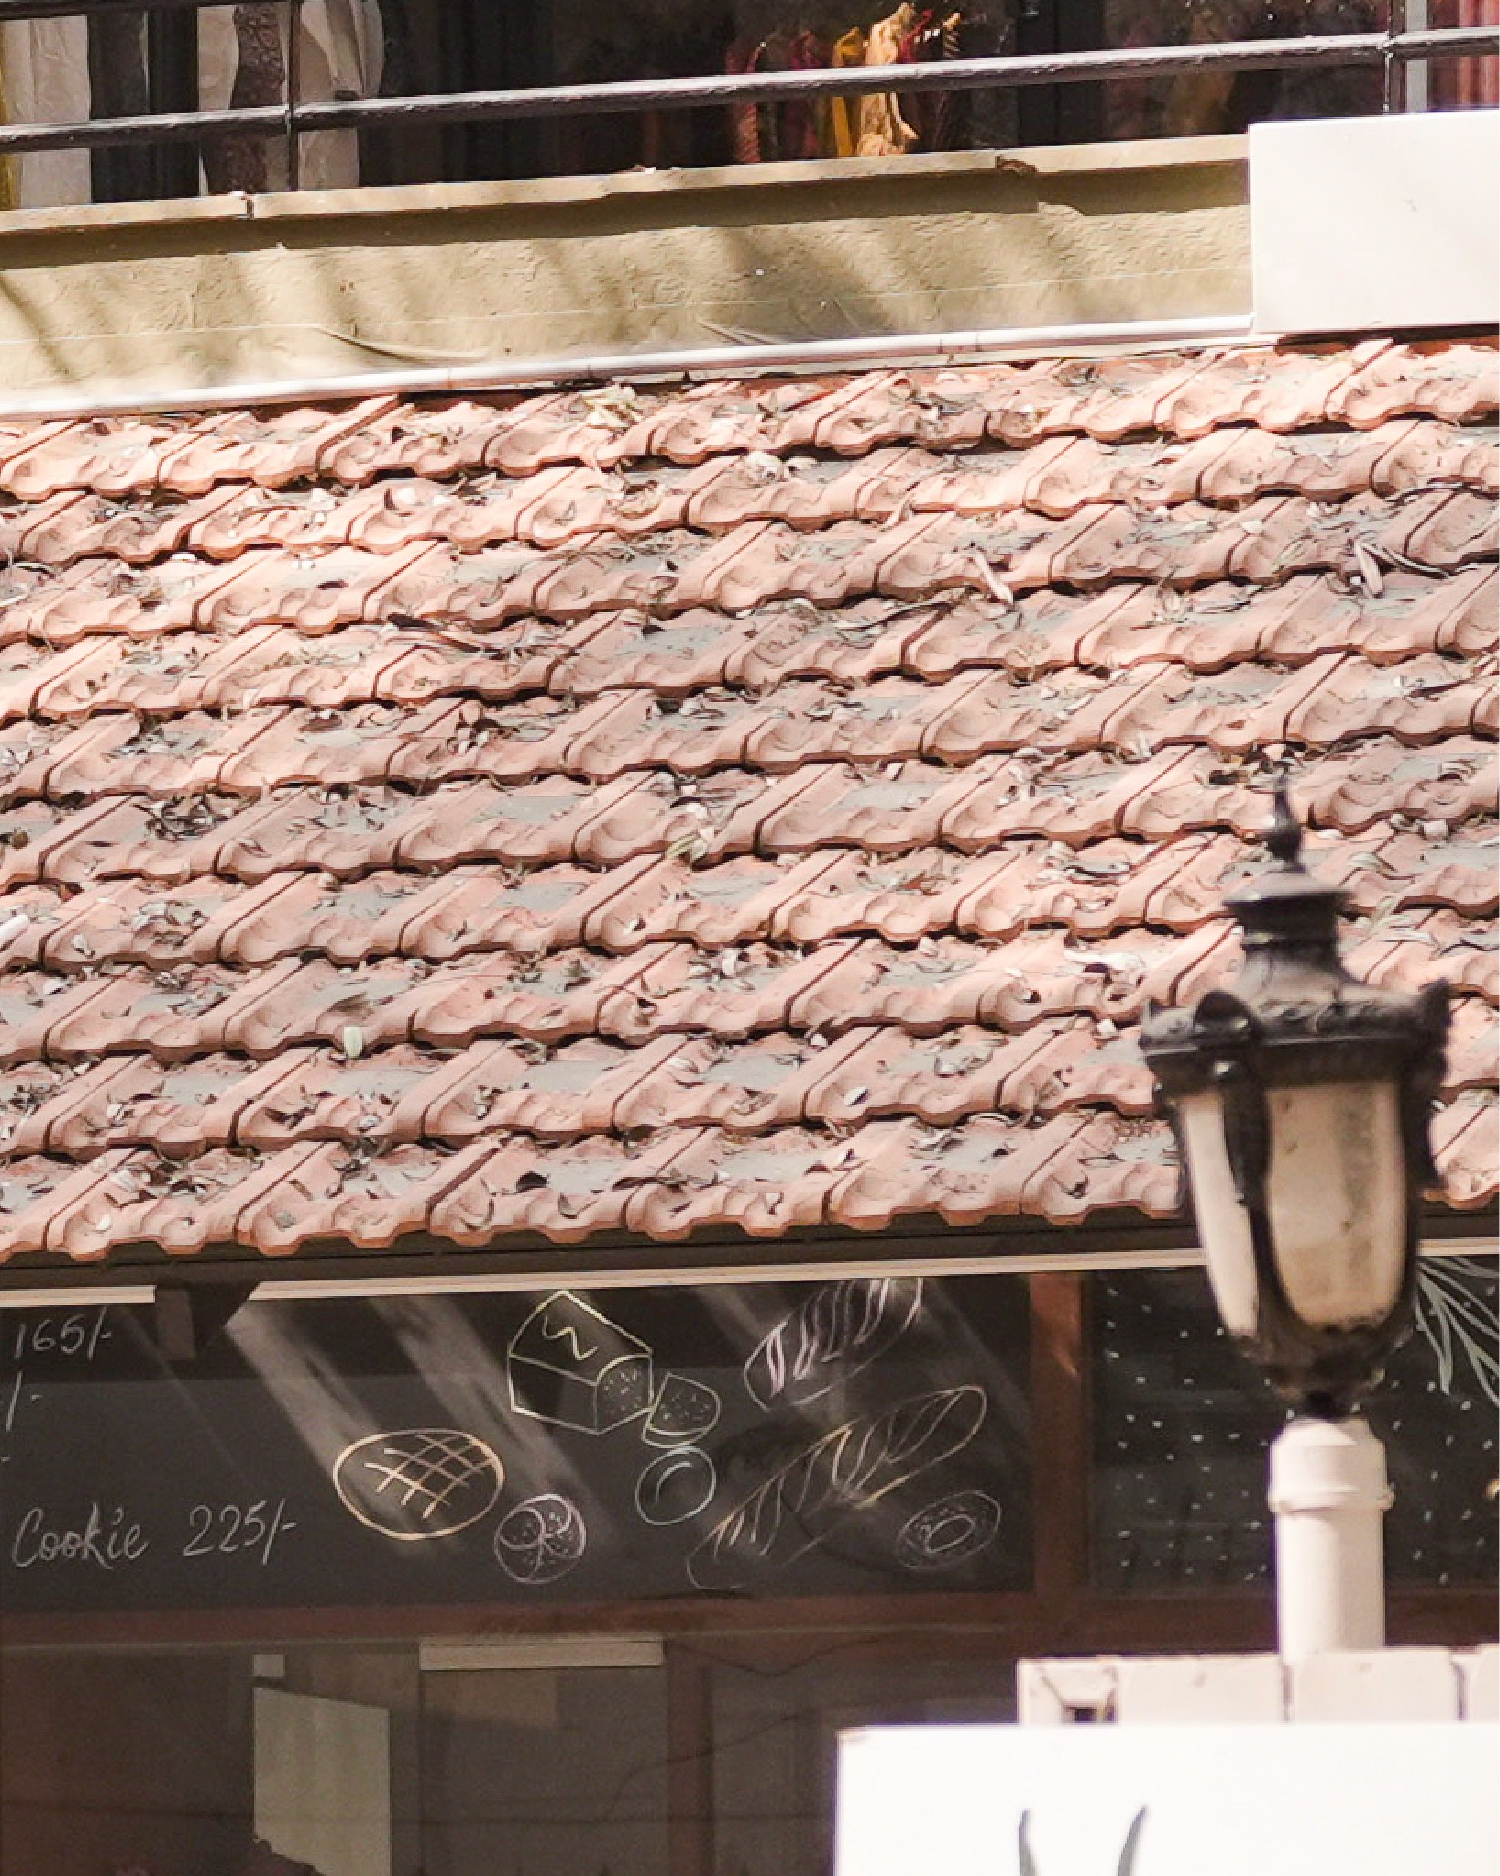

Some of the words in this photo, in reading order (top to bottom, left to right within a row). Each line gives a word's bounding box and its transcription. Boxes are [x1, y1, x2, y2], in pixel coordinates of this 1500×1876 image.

[15, 1306, 112, 1360] 165/-
[11, 1502, 150, 1570] Cookie
[183, 1498, 297, 1565] 225/-
